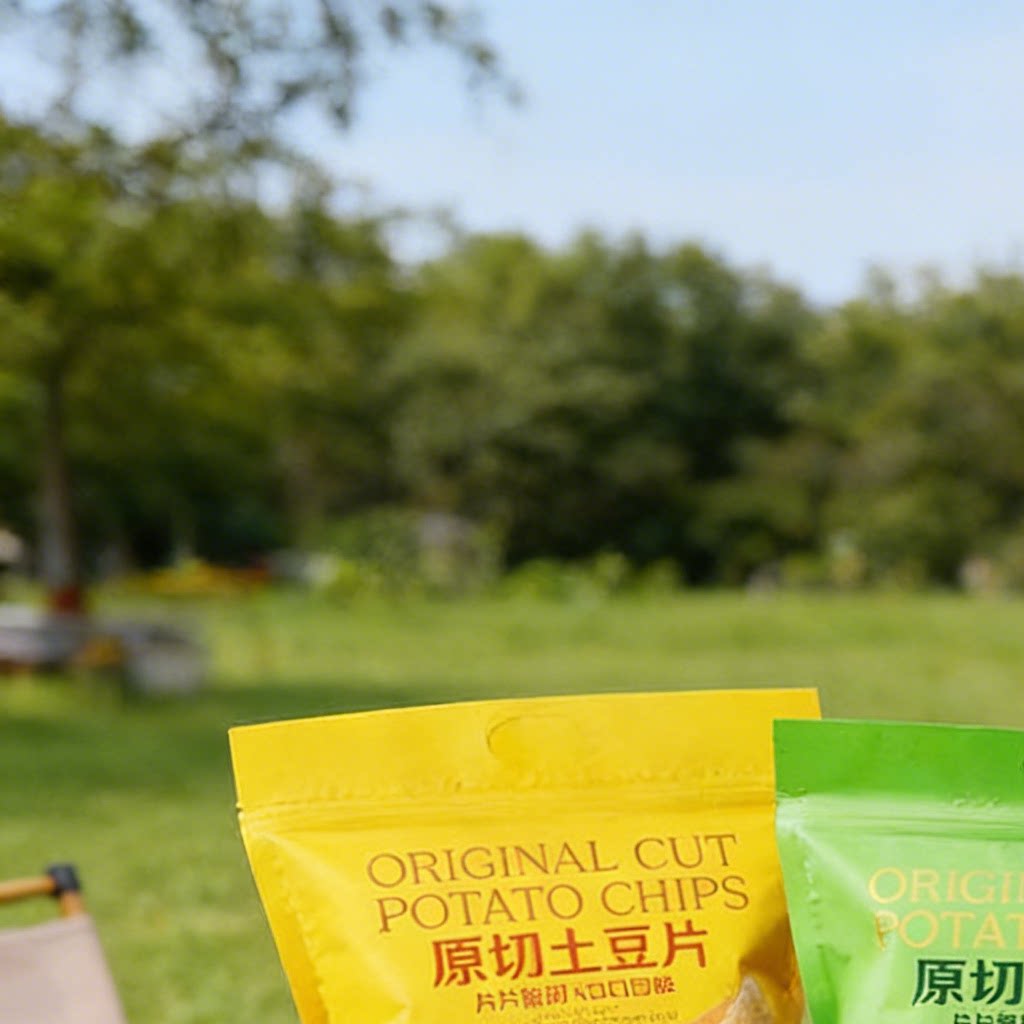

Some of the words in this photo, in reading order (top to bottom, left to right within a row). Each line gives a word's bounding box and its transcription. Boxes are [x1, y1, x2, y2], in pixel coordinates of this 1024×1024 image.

[366, 840, 618, 889] ORIGINAL
[633, 834, 738, 872] CUT
[376, 884, 584, 934] POTATO
[600, 875, 750, 917] CHIPS
[431, 918, 709, 988] 原切土豆片
